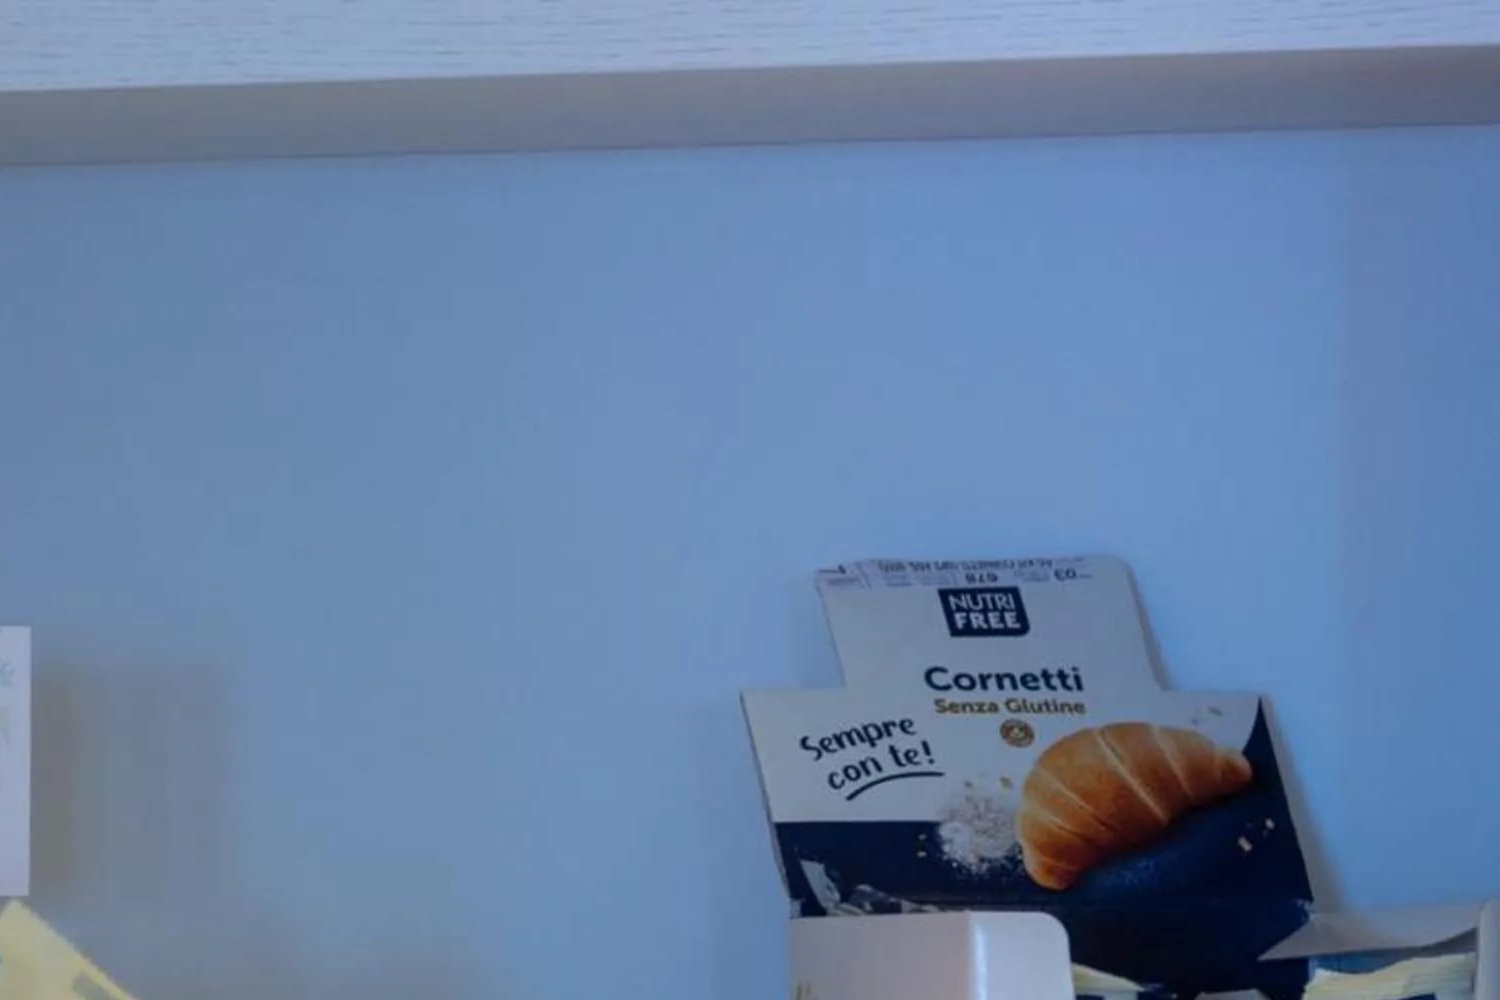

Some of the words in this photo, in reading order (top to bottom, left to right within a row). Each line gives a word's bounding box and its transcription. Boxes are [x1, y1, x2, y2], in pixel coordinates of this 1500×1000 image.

[949, 593, 1016, 611] NUTRI
[954, 611, 1021, 629] FREE
[924, 666, 1085, 692] Cornetti
[933, 698, 1000, 714] Senza
[1004, 698, 1086, 714] Glutine
[800, 717, 917, 761] Sempre
[828, 753, 883, 790] con
[889, 740, 935, 768] te!
